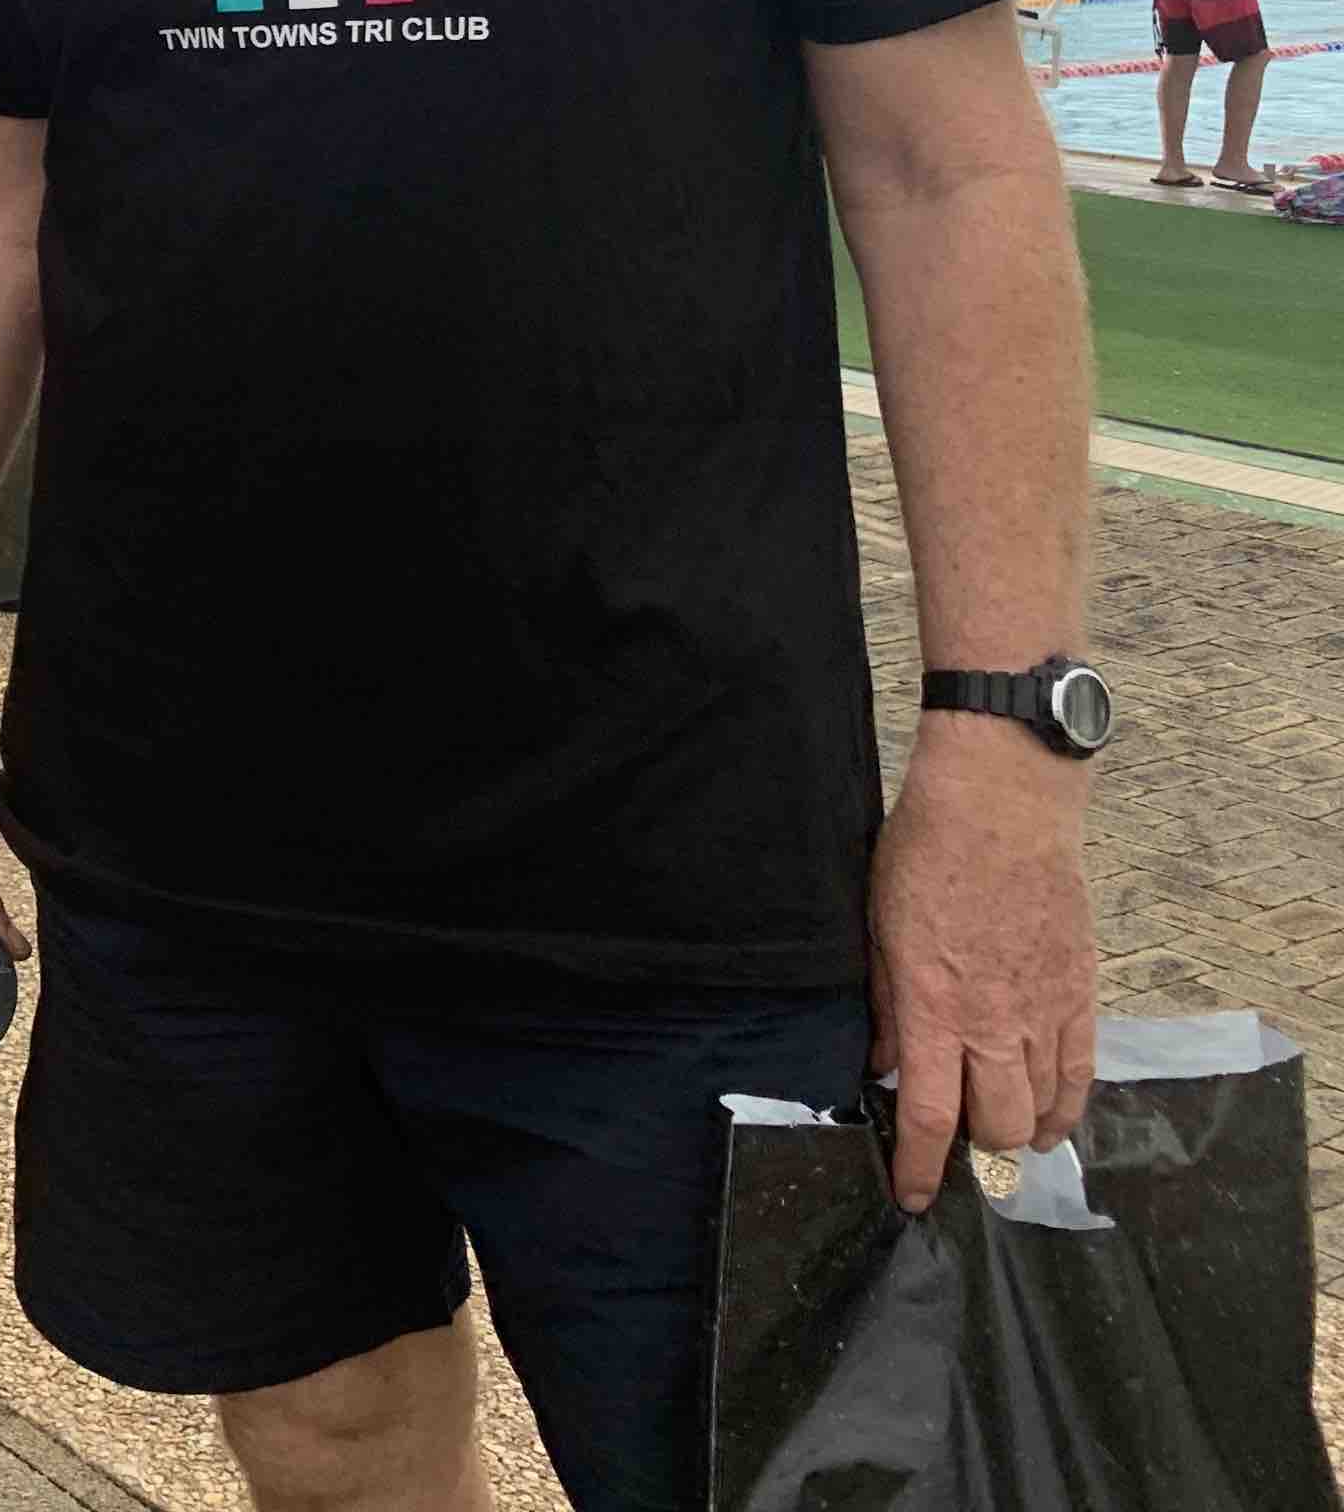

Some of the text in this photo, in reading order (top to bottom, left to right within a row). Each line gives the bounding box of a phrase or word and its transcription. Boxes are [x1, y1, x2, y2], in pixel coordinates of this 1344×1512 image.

[160, 16, 491, 50] TWIN TOWNS TRI CLUB
